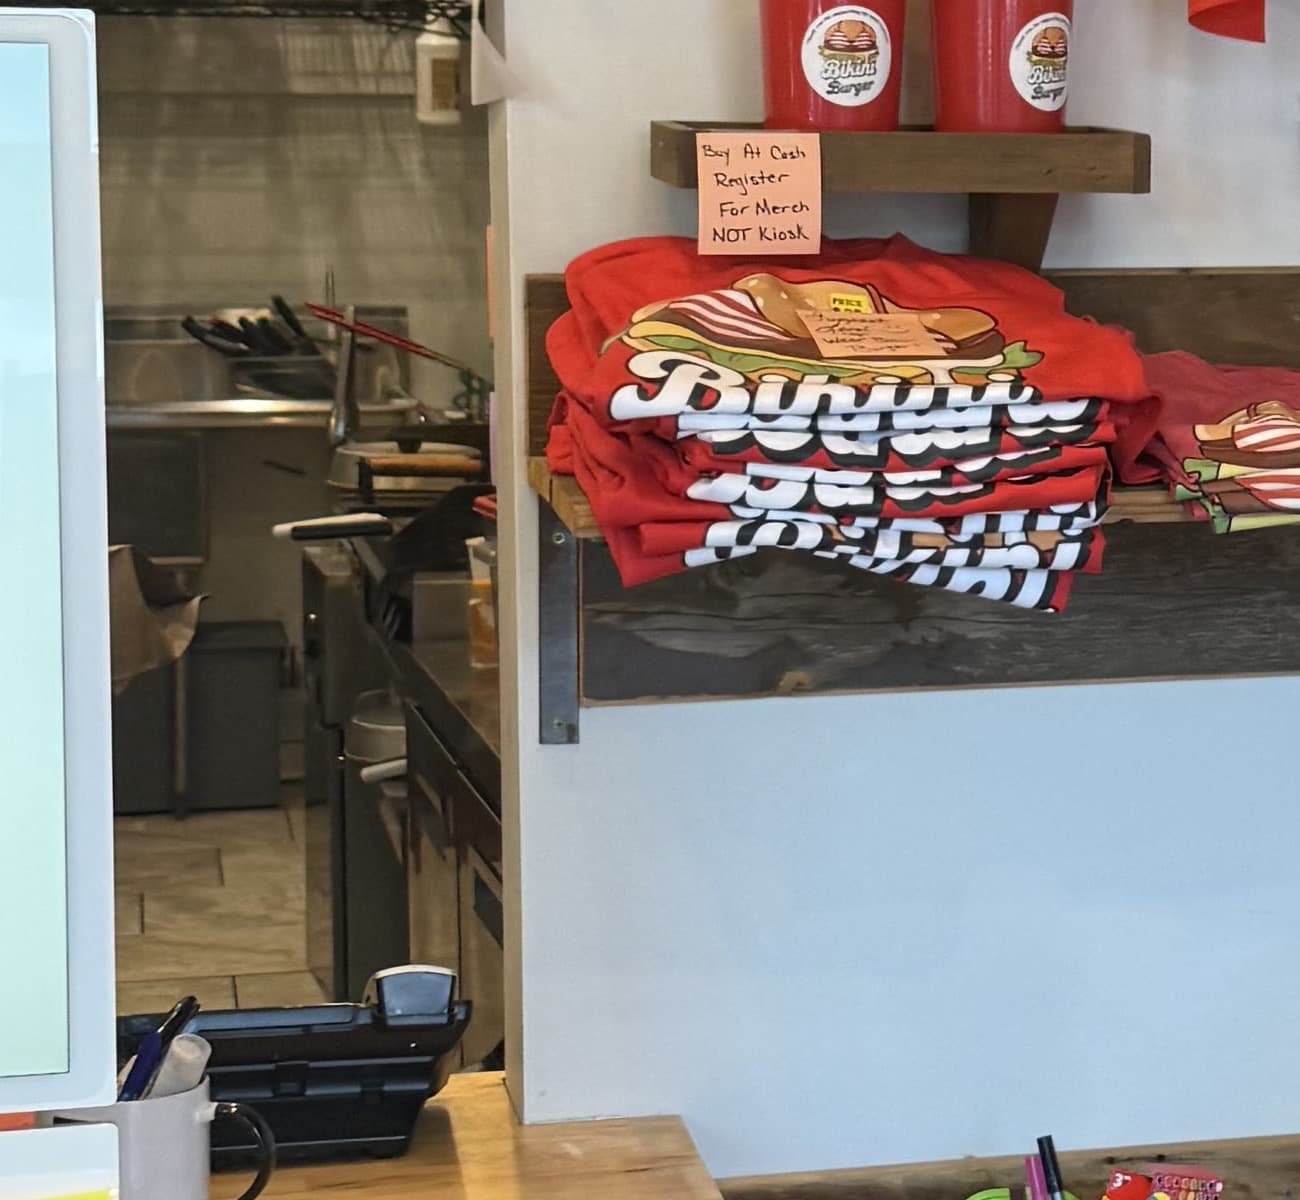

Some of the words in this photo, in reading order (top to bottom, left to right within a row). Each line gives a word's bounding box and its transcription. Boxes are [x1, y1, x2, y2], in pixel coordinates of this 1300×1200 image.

[821, 59, 877, 81] Bikini
[825, 80, 875, 97] Burger
[702, 144, 730, 167] Buy
[743, 142, 761, 160] At
[770, 144, 806, 161] Cash
[713, 169, 791, 197] Register
[720, 201, 751, 218] For
[755, 197, 810, 216] Merch
[712, 227, 753, 243] NOT
[758, 223, 810, 242] Kiosk
